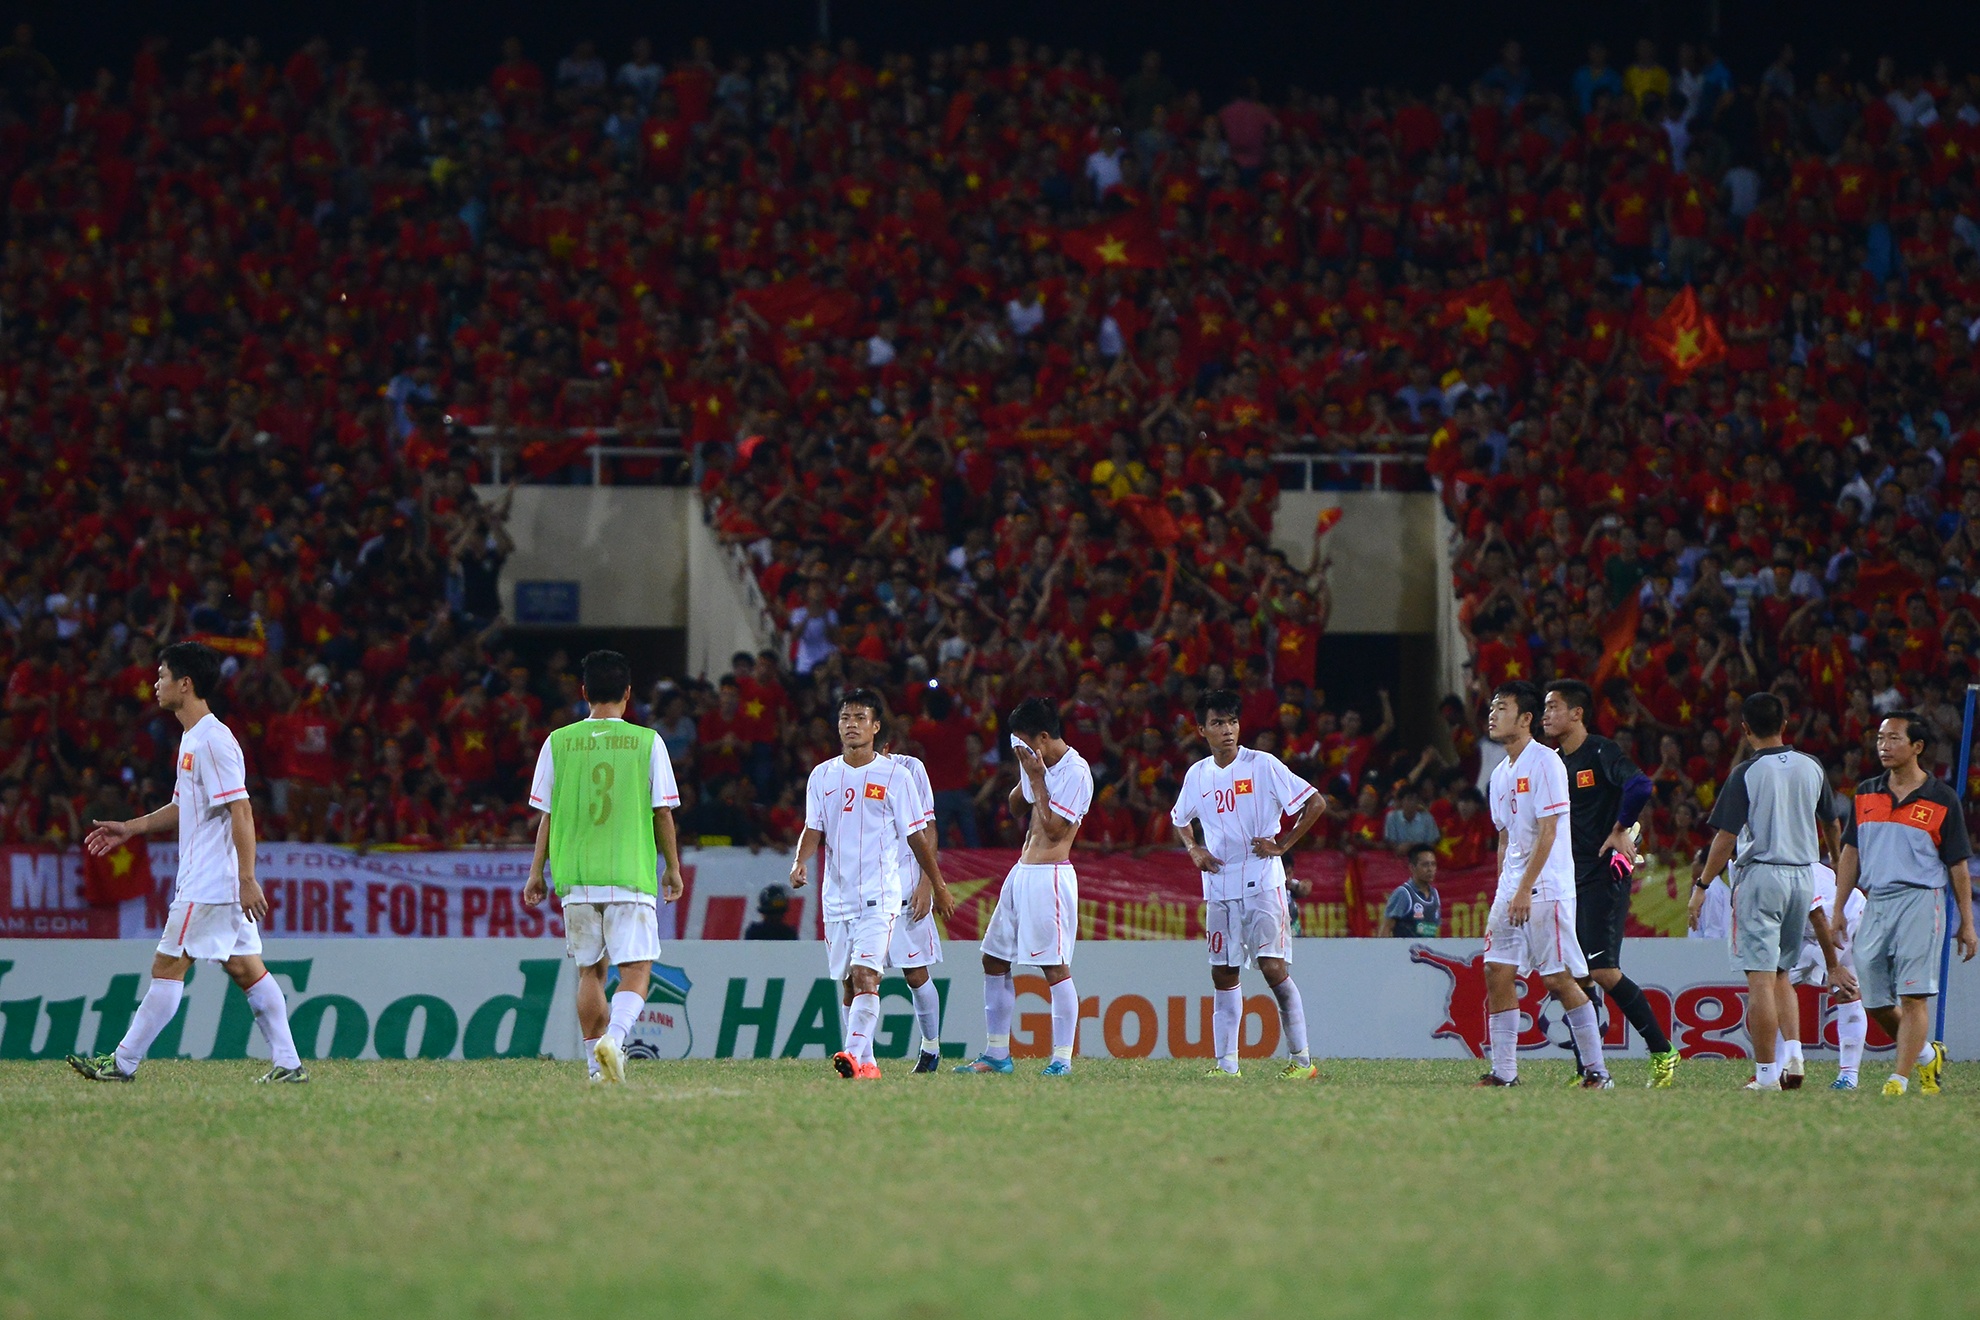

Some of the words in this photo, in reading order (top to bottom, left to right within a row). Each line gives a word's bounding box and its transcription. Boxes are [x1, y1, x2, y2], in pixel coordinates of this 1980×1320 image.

[588, 761, 615, 826] 3
[843, 787, 856, 812] 2
[1214, 788, 1236, 814] 20
[263, 877, 353, 935] FIRE
[366, 882, 448, 936] FOR
[461, 886, 566, 938] PASS
[0, 957, 562, 1060] utiFood
[715, 976, 968, 1059] HAGL
[1009, 973, 1282, 1060] Group
